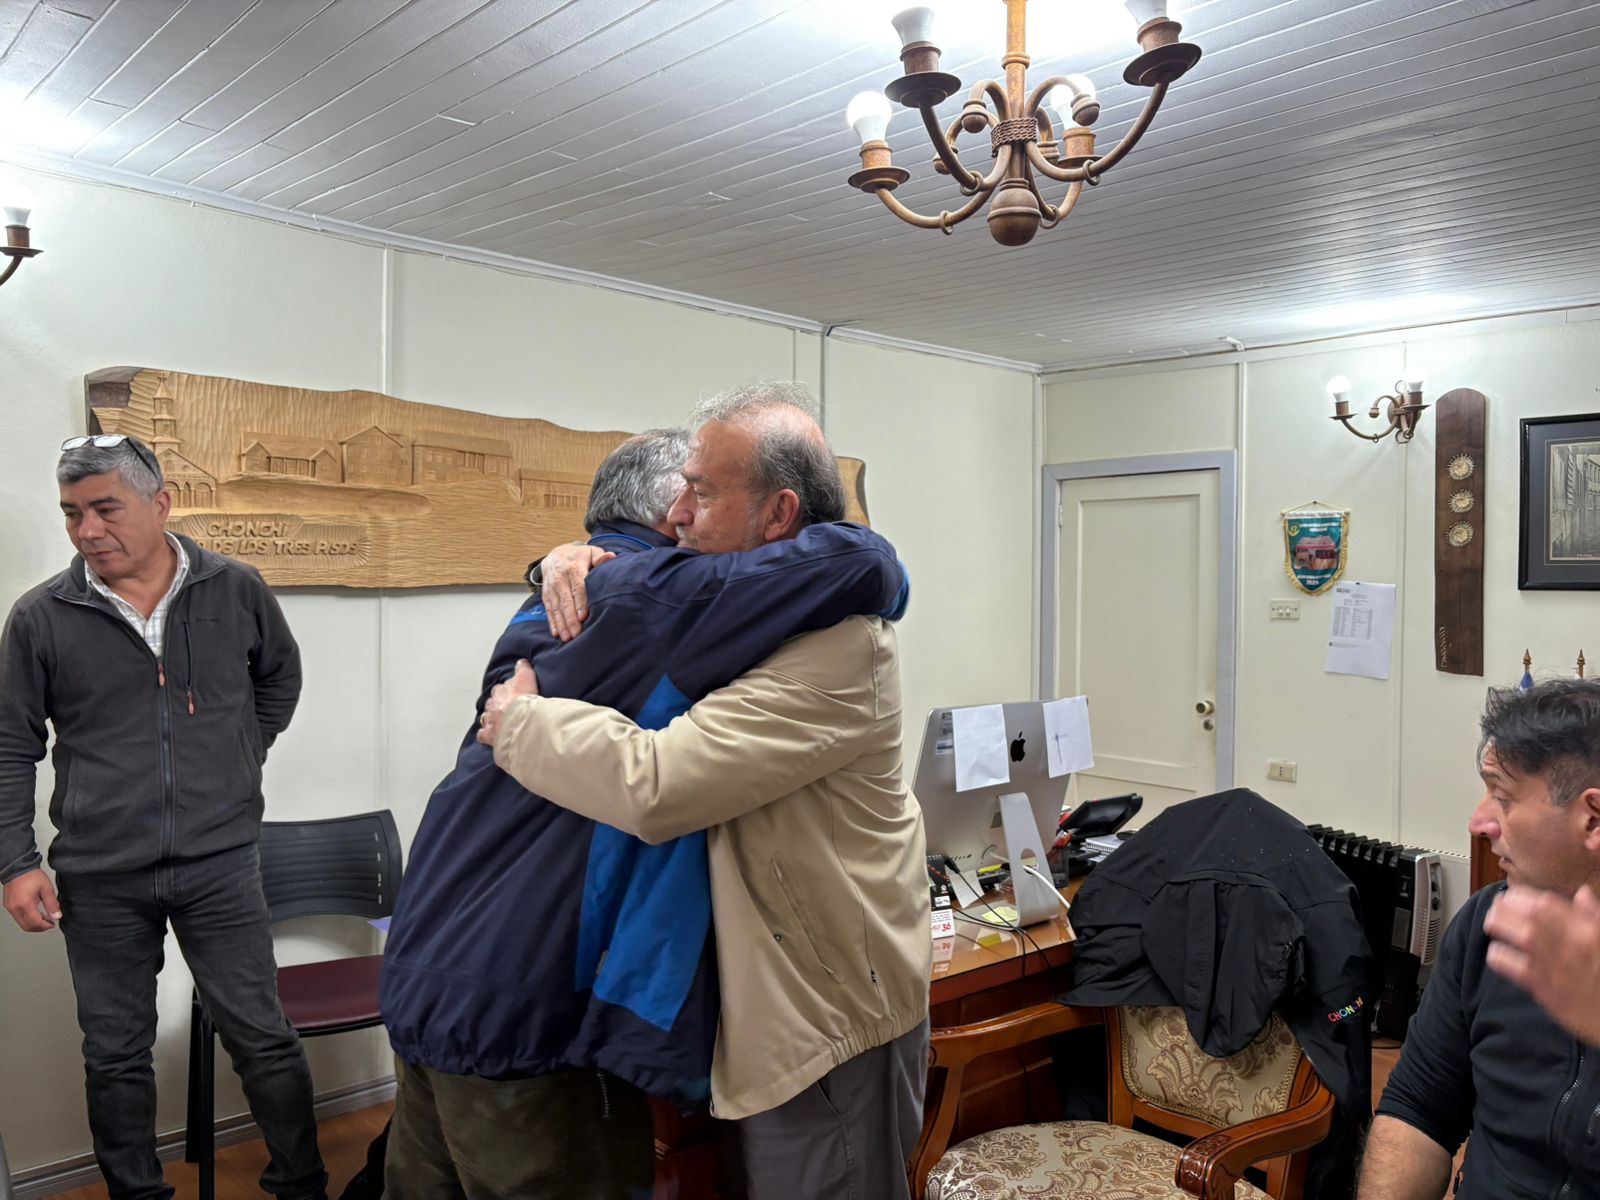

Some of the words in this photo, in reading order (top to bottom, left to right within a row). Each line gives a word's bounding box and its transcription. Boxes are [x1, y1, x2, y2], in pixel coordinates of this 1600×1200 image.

[237, 540, 268, 556] LOS
[273, 540, 310, 556] TRES
[314, 540, 358, 556] PISOS
